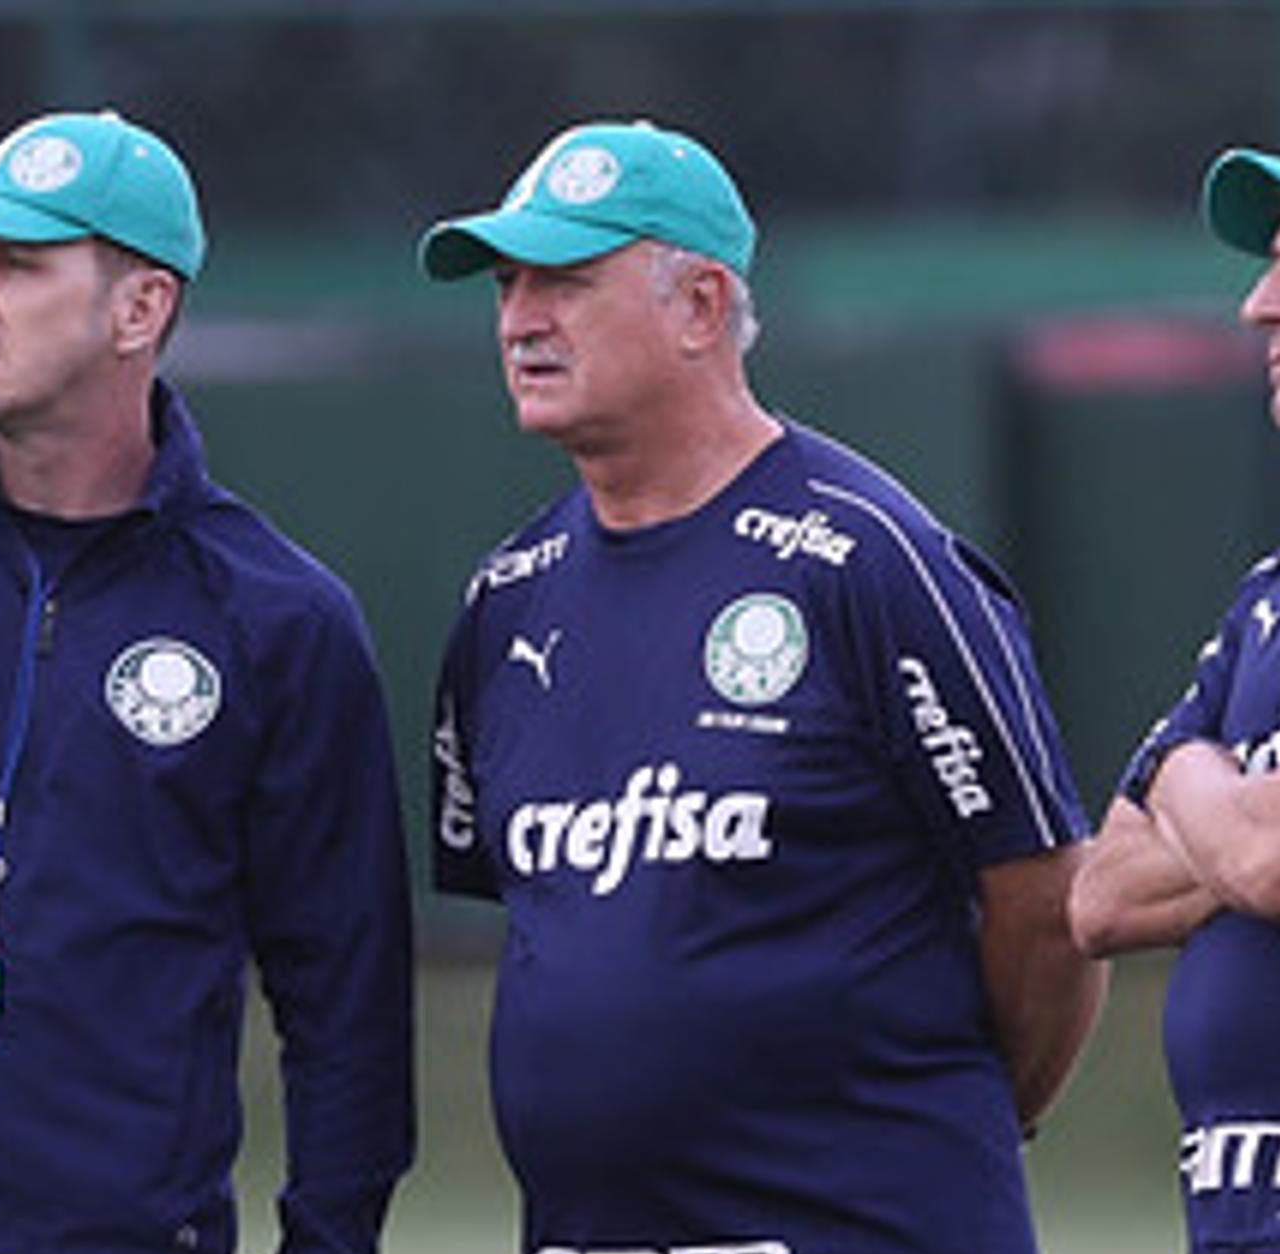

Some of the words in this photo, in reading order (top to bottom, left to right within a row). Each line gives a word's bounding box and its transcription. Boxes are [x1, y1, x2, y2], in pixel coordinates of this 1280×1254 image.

[733, 508, 856, 565] crefisa
[897, 657, 993, 817] crefisa
[507, 762, 772, 895] crefisa
